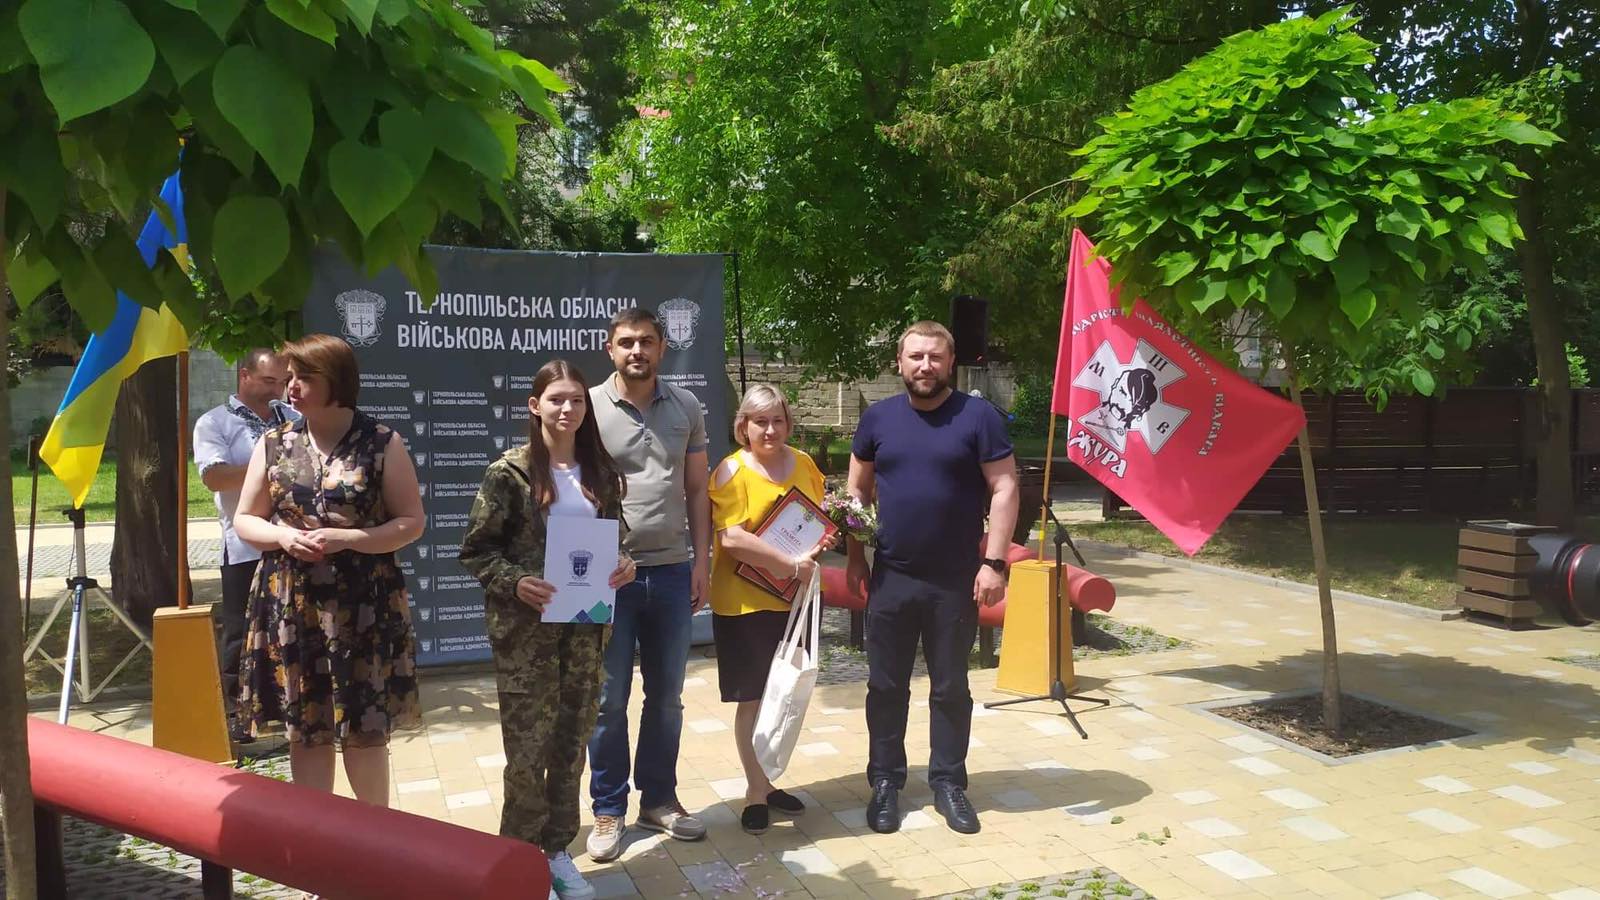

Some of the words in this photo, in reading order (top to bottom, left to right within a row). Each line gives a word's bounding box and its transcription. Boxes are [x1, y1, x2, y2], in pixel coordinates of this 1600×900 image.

[405, 291, 554, 319] ТЕРНОПІЛЬСЬКА
[560, 296, 637, 319] ОБЛАСНА
[398, 321, 505, 350] ВІЙСЬКОВА
[511, 328, 608, 353] АДМІНІСТР
[1149, 354, 1168, 372] Ш
[1068, 419, 1127, 478] ЖУРА
